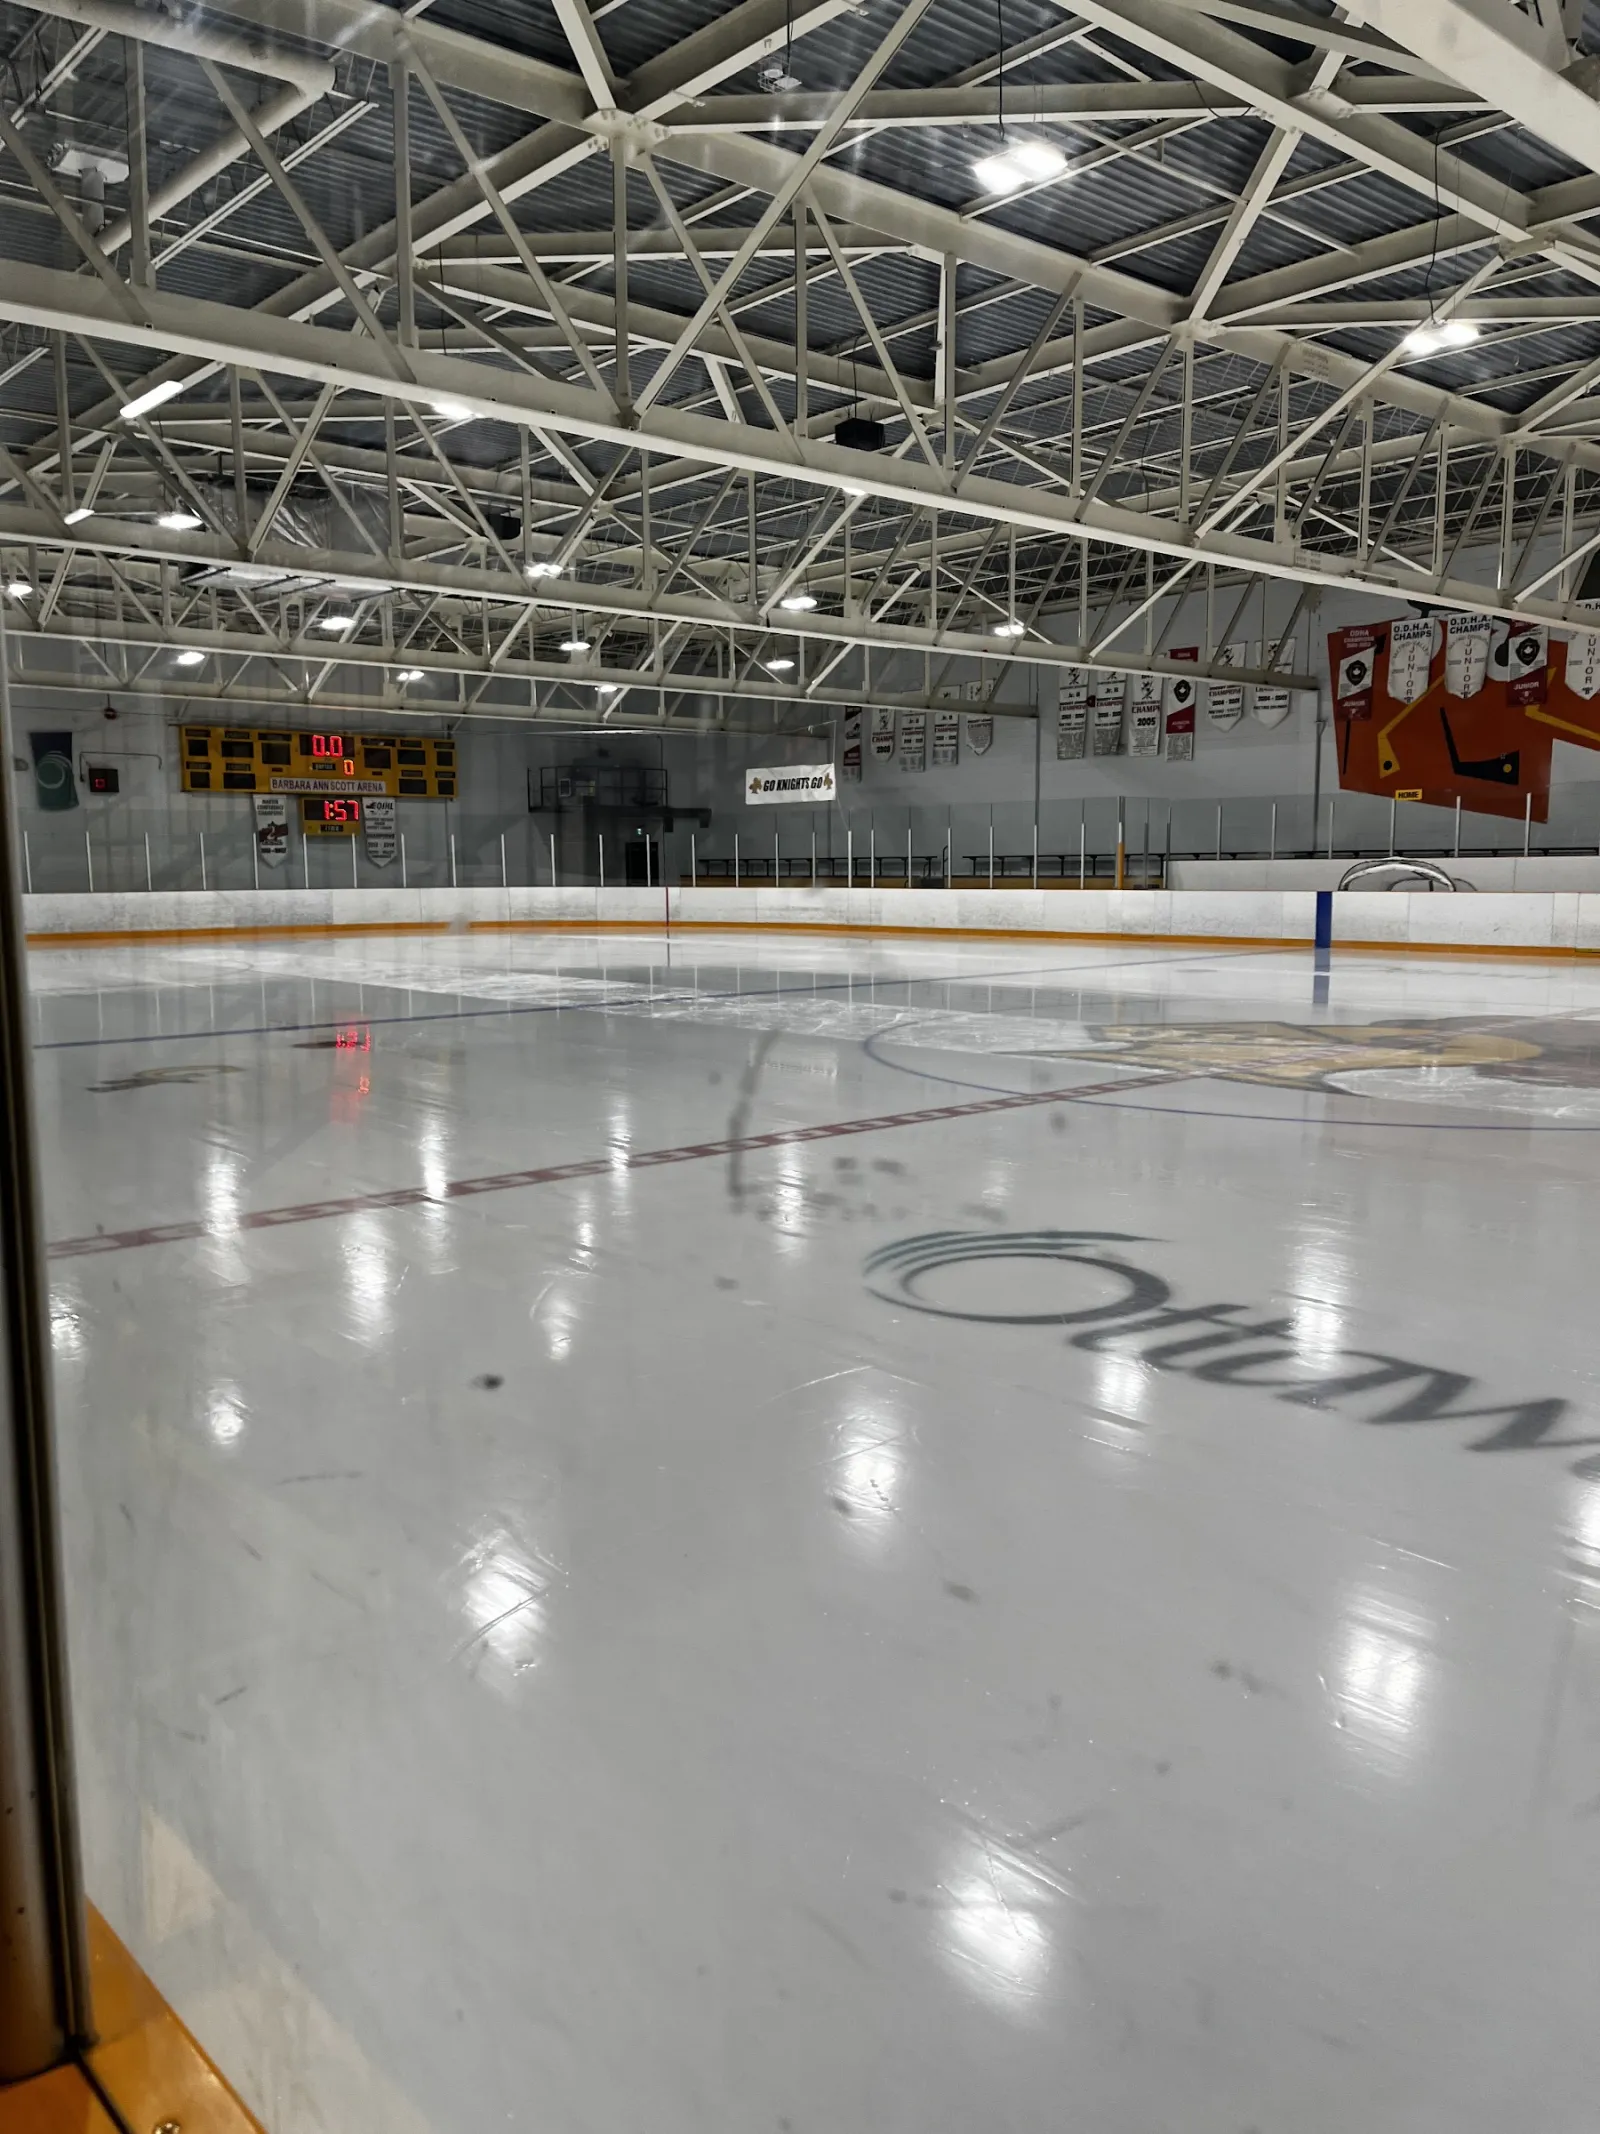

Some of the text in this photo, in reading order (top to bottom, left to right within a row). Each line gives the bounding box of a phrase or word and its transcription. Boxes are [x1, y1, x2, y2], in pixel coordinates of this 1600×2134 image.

[1393, 622, 1432, 633] O.D.H.A.
[1449, 623, 1491, 634] CHAMPS
[1393, 630, 1432, 641] CHAMPS
[1137, 717, 1156, 726] 2005
[312, 735, 343, 757] 0.0
[272, 779, 384, 792] BARBARA ANN SCOTT ARENA
[763, 777, 823, 792] GO KNIGHTS GO
[1397, 790, 1420, 799] HOME
[324, 800, 359, 821] 1:57
